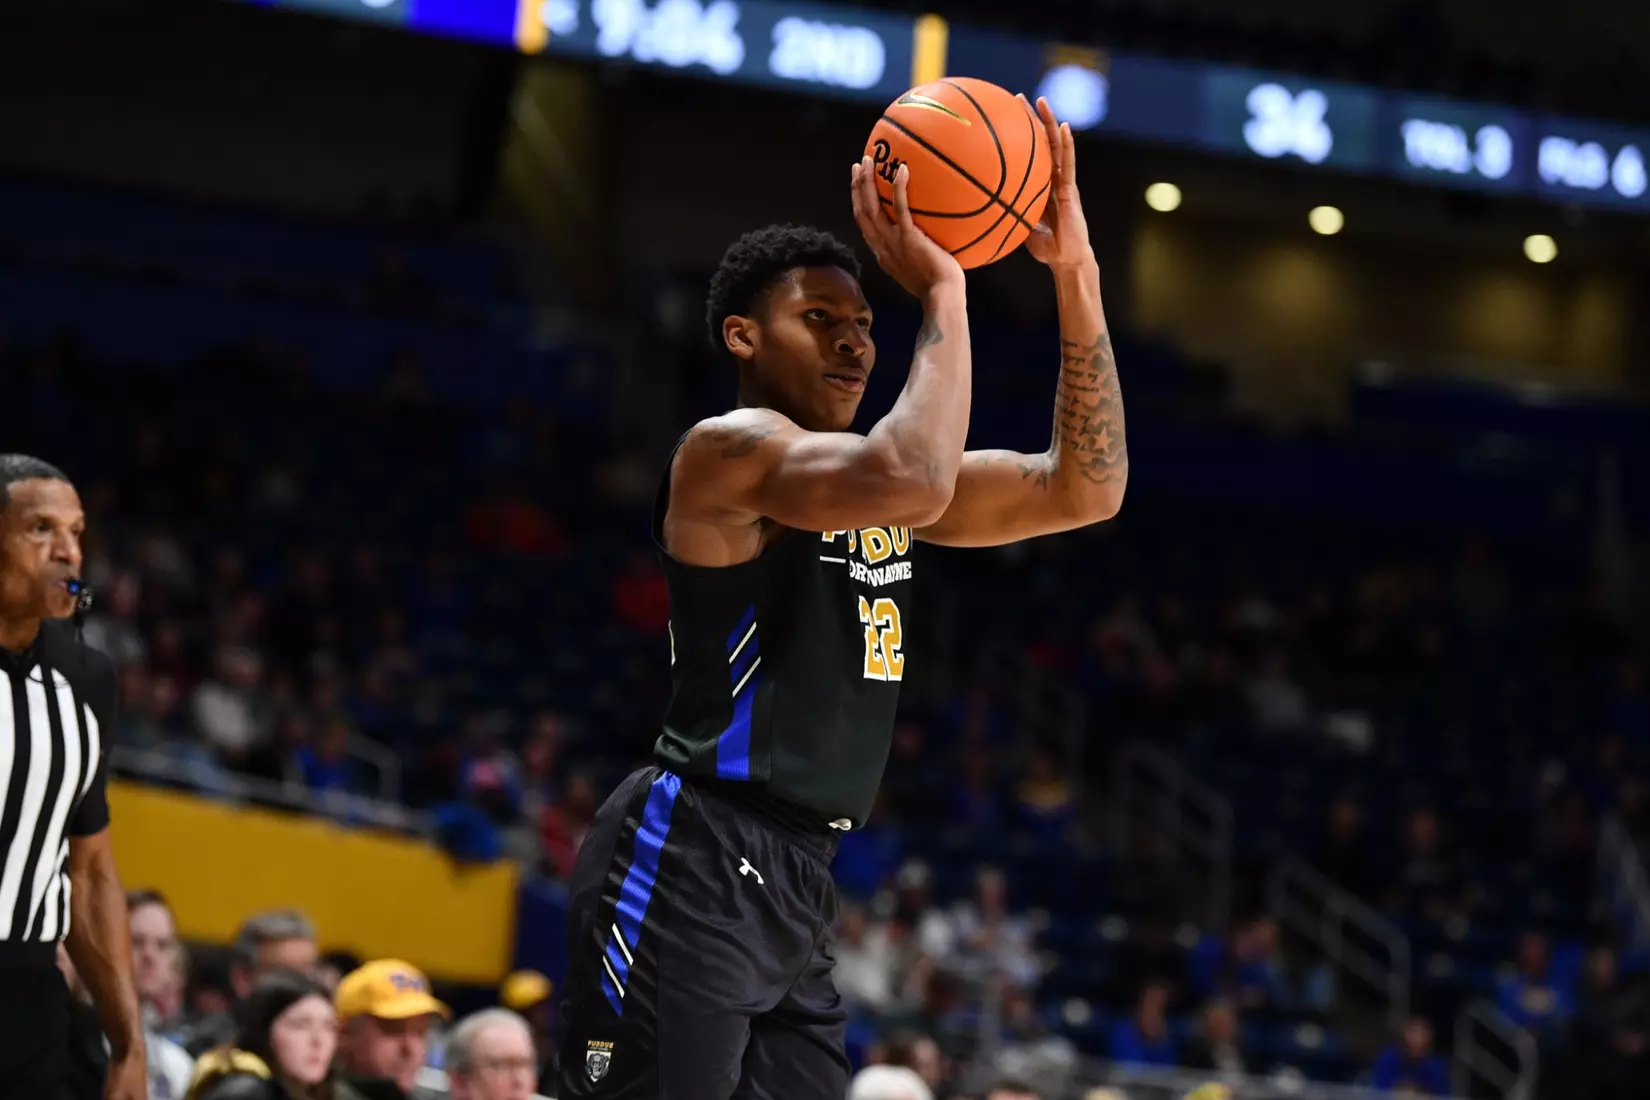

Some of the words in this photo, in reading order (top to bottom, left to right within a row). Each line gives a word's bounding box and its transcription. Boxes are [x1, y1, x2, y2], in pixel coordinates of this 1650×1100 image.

[770, 17, 885, 89] 2ND
[873, 139, 907, 184] Pit
[858, 595, 905, 681] 22
[588, 1040, 614, 1049] PURDUE
